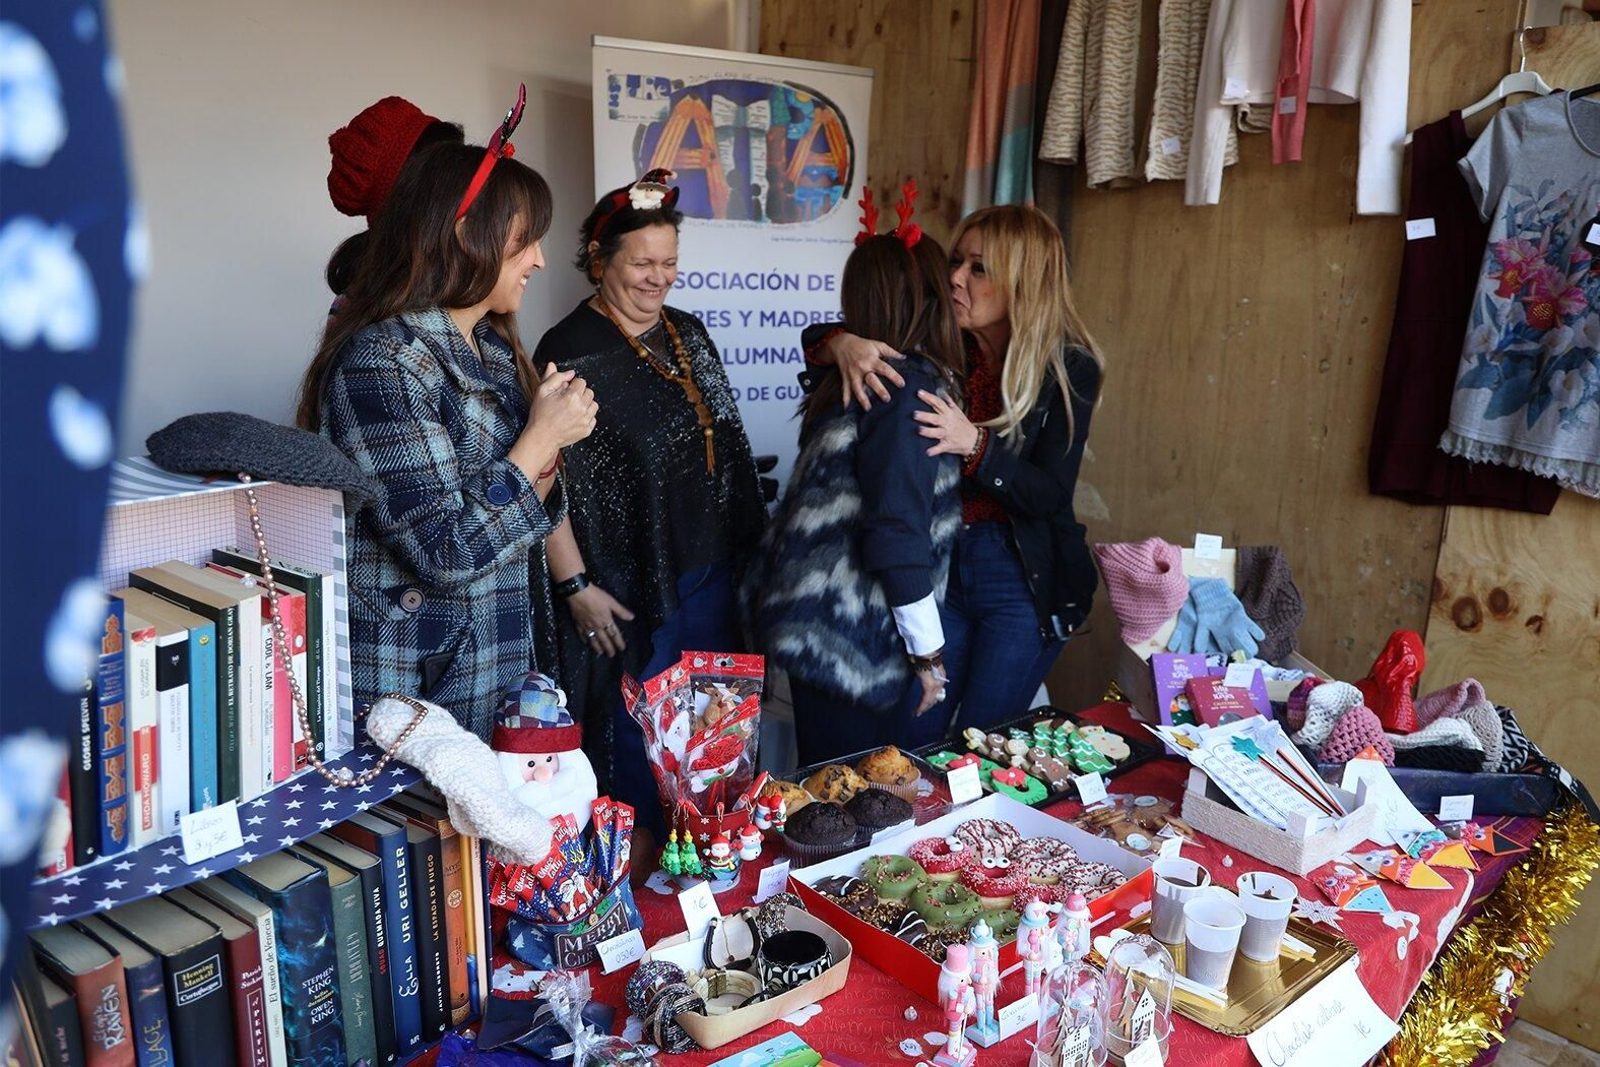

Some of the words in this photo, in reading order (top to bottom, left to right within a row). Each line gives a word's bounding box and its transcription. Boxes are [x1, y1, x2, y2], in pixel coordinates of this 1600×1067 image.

[673, 268, 800, 291] SOCIACIÓN
[807, 274, 835, 291] DE
[692, 310, 731, 328] RES
[739, 310, 753, 328] Y
[760, 310, 845, 328] MADRES
[723, 347, 805, 365] LUMNA
[747, 387, 770, 401] DE
[264, 637, 273, 660] COOL
[227, 665, 235, 697] RETRATO
[264, 671, 273, 691] LAM
[80, 697, 92, 734] SPELVIN
[81, 734, 92, 771] GEORGE
[141, 753, 151, 797] HOWARD
[141, 798, 152, 830] LINDA
[395, 846, 409, 909] GELLER
[427, 854, 435, 883] FUEGO
[537, 857, 553, 879] Choco
[514, 868, 527, 892] Choco
[373, 886, 381, 908] VIVA
[497, 881, 508, 906] Choco
[430, 899, 439, 929] ESPADA
[262, 917, 274, 952] Venecia
[375, 908, 385, 947] QUEMADA
[400, 914, 411, 943] URI
[564, 906, 622, 953] MERRY
[265, 952, 274, 963] de
[181, 963, 214, 982] Henning
[183, 970, 214, 988] Mankell
[267, 964, 277, 991] sueño
[302, 965, 334, 988] STEPHEN
[308, 976, 332, 995] KING
[268, 993, 278, 1003] El
[310, 998, 334, 1016] OWEN
[311, 1005, 334, 1025] KING
[253, 1009, 266, 1067] PERFUM
